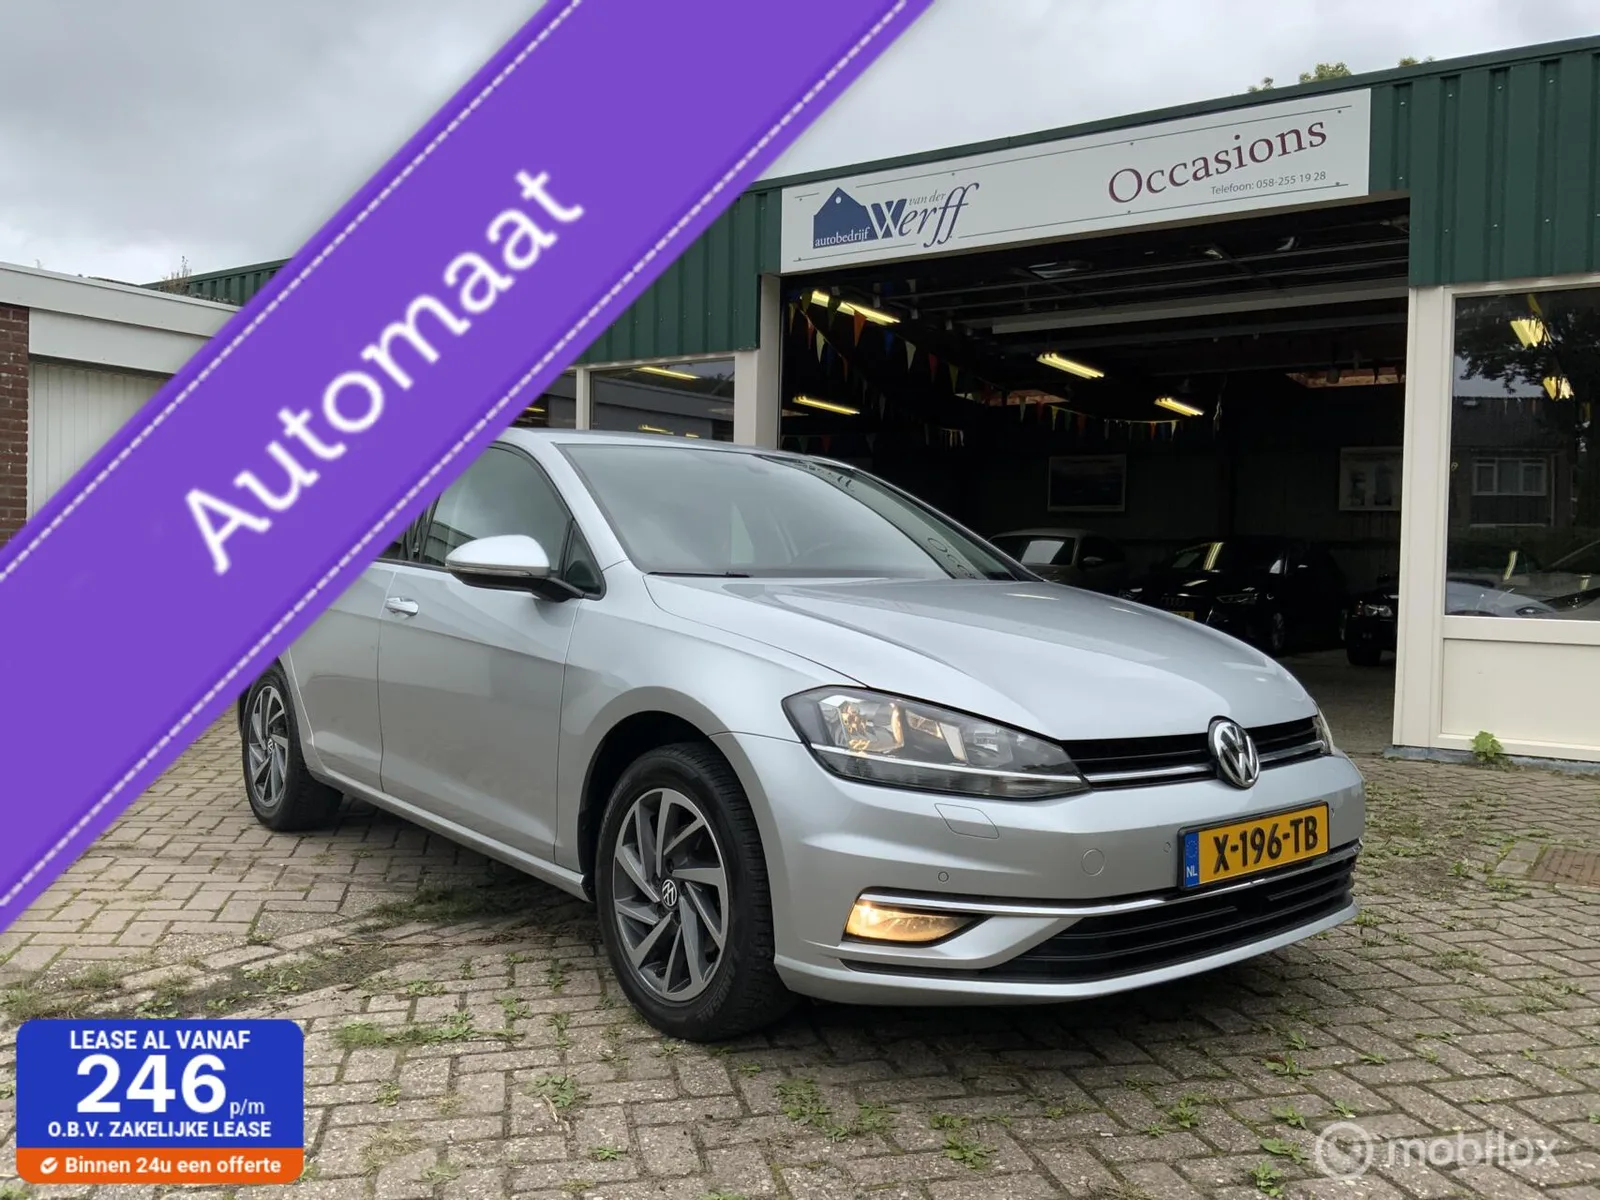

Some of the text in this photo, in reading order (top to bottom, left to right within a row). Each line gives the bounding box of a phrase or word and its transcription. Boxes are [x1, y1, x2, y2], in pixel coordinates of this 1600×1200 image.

[1108, 121, 1327, 203] Occasions
[1211, 170, 1326, 195] Telefoon: 058-255 19 28
[814, 182, 980, 248] autobedrijf Werff
[909, 189, 946, 206] van der
[1213, 815, 1318, 874] X-196-TB
[1186, 865, 1198, 877] NL
